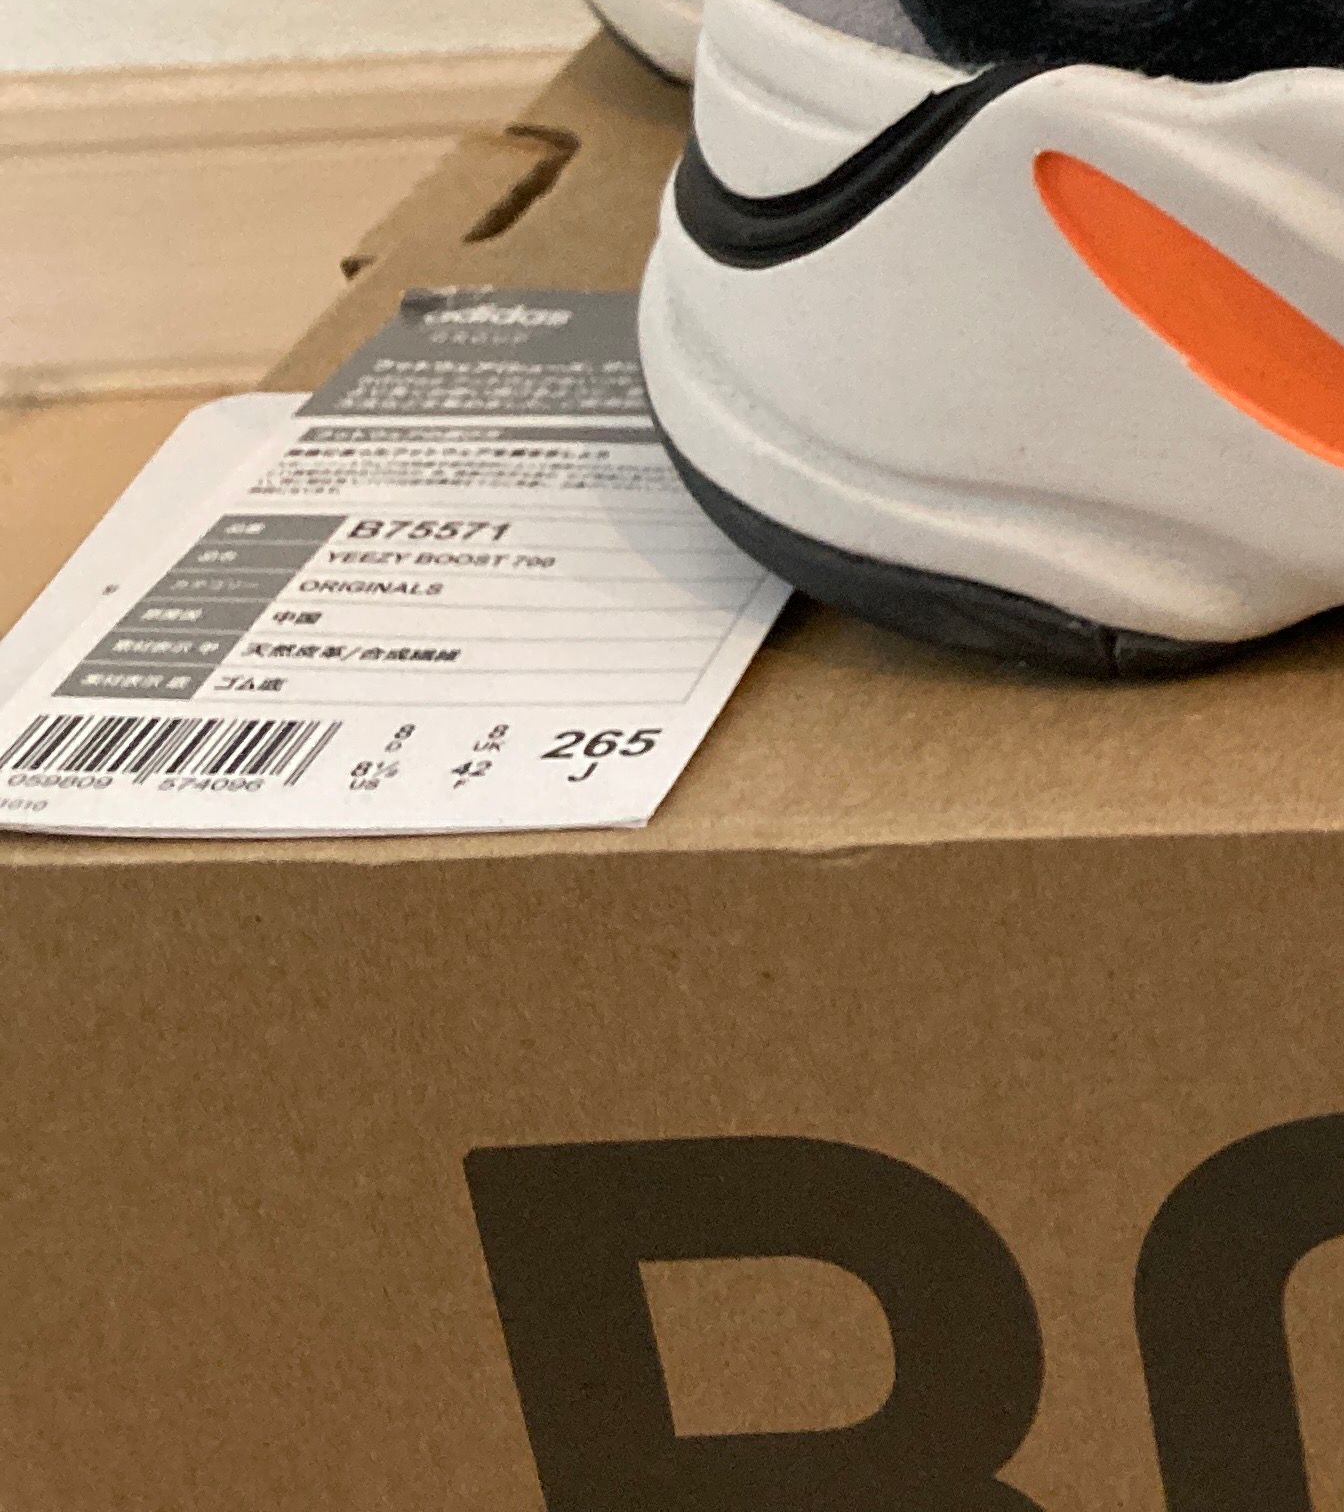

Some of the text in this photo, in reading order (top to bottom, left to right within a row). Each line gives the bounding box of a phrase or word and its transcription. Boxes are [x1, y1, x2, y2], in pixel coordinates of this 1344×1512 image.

[346, 519, 511, 541] B75571
[328, 550, 412, 566] YEEZY
[413, 552, 510, 568] BOOST
[299, 579, 445, 596] ORIGINALS
[472, 740, 507, 753] UK
[539, 727, 664, 760] 265
[451, 759, 493, 777] 42
[566, 761, 600, 783] J
